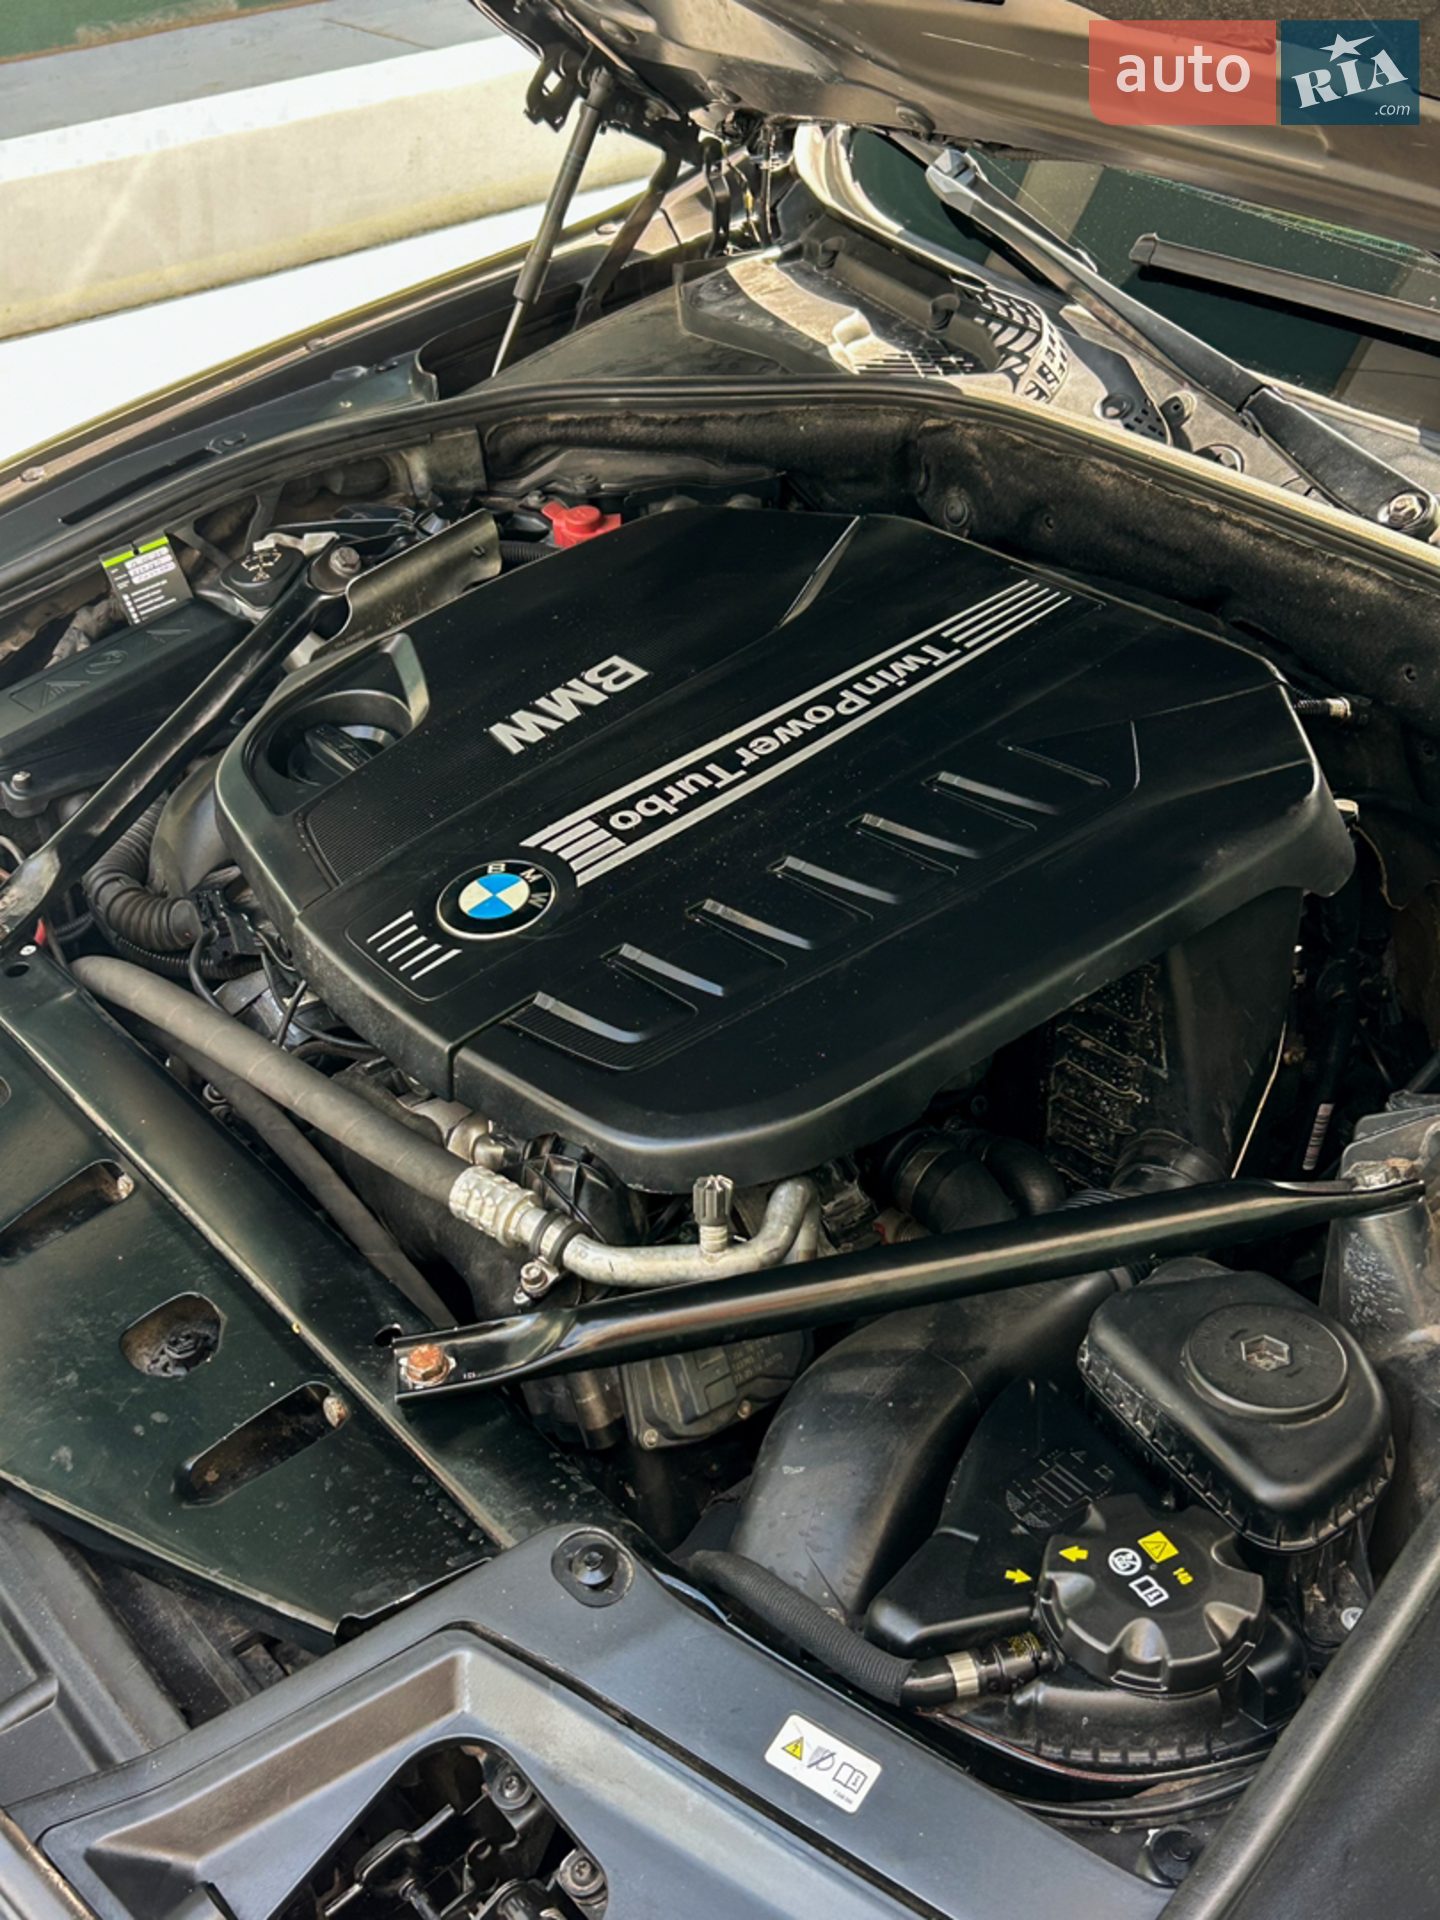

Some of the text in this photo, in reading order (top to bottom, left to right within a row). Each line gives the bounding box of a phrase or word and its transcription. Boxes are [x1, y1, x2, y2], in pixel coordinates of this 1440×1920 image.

[488, 654, 650, 755] BMW
[735, 644, 961, 767] TwinPower
[487, 863, 550, 910] BMW
